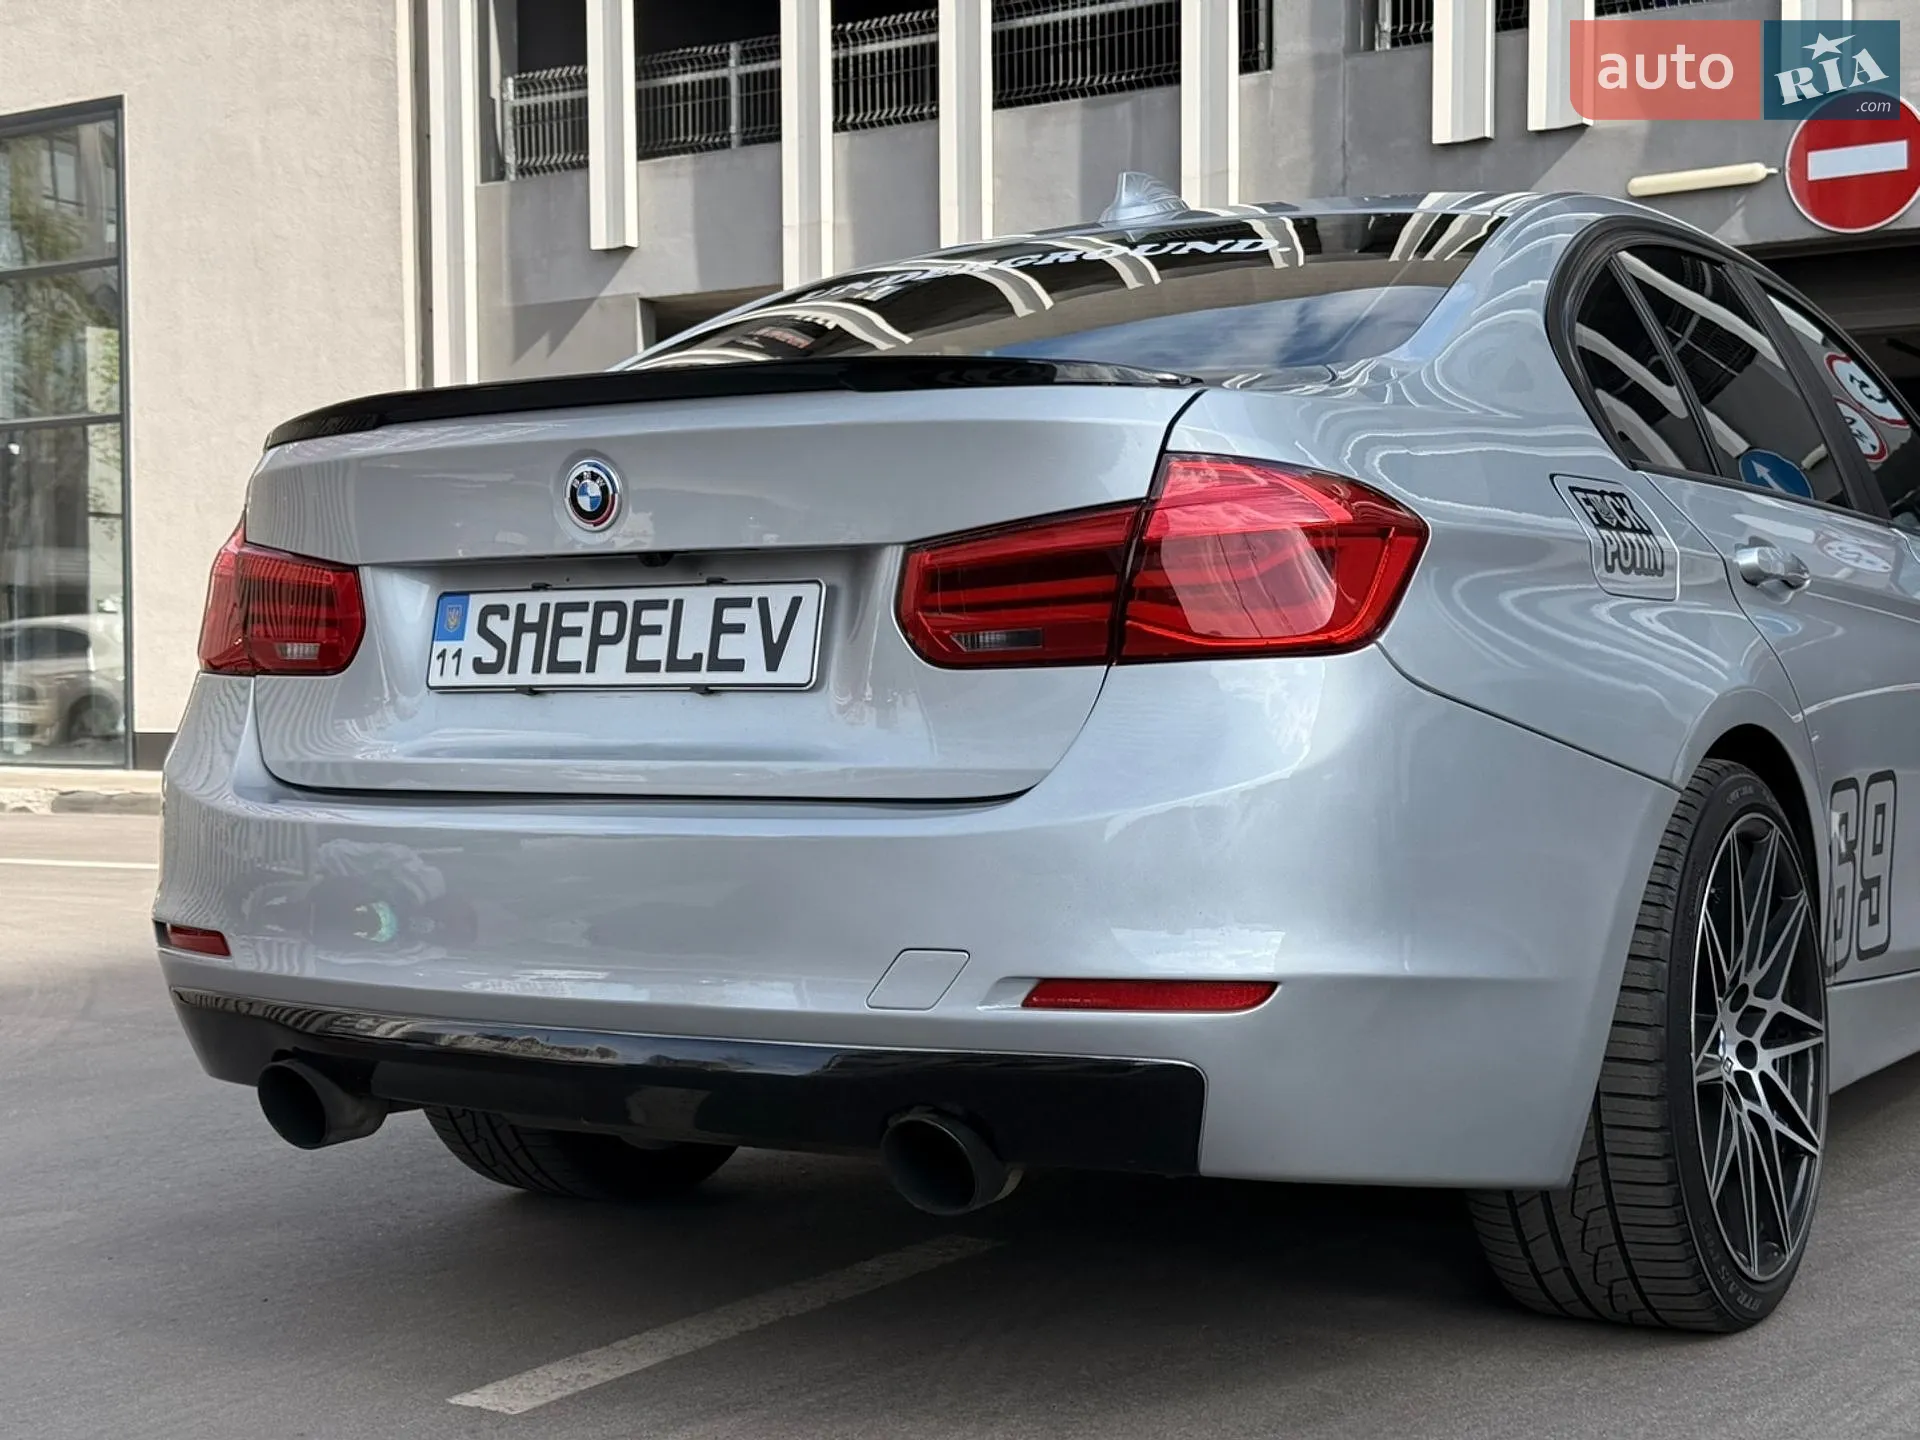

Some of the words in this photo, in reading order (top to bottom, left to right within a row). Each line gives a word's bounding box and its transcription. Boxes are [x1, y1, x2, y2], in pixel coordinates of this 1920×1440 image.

[1600, 530, 1664, 575] PUTIN
[436, 647, 463, 677] 11
[472, 596, 803, 675] SHEPELEV
[1824, 769, 1896, 978] 69
